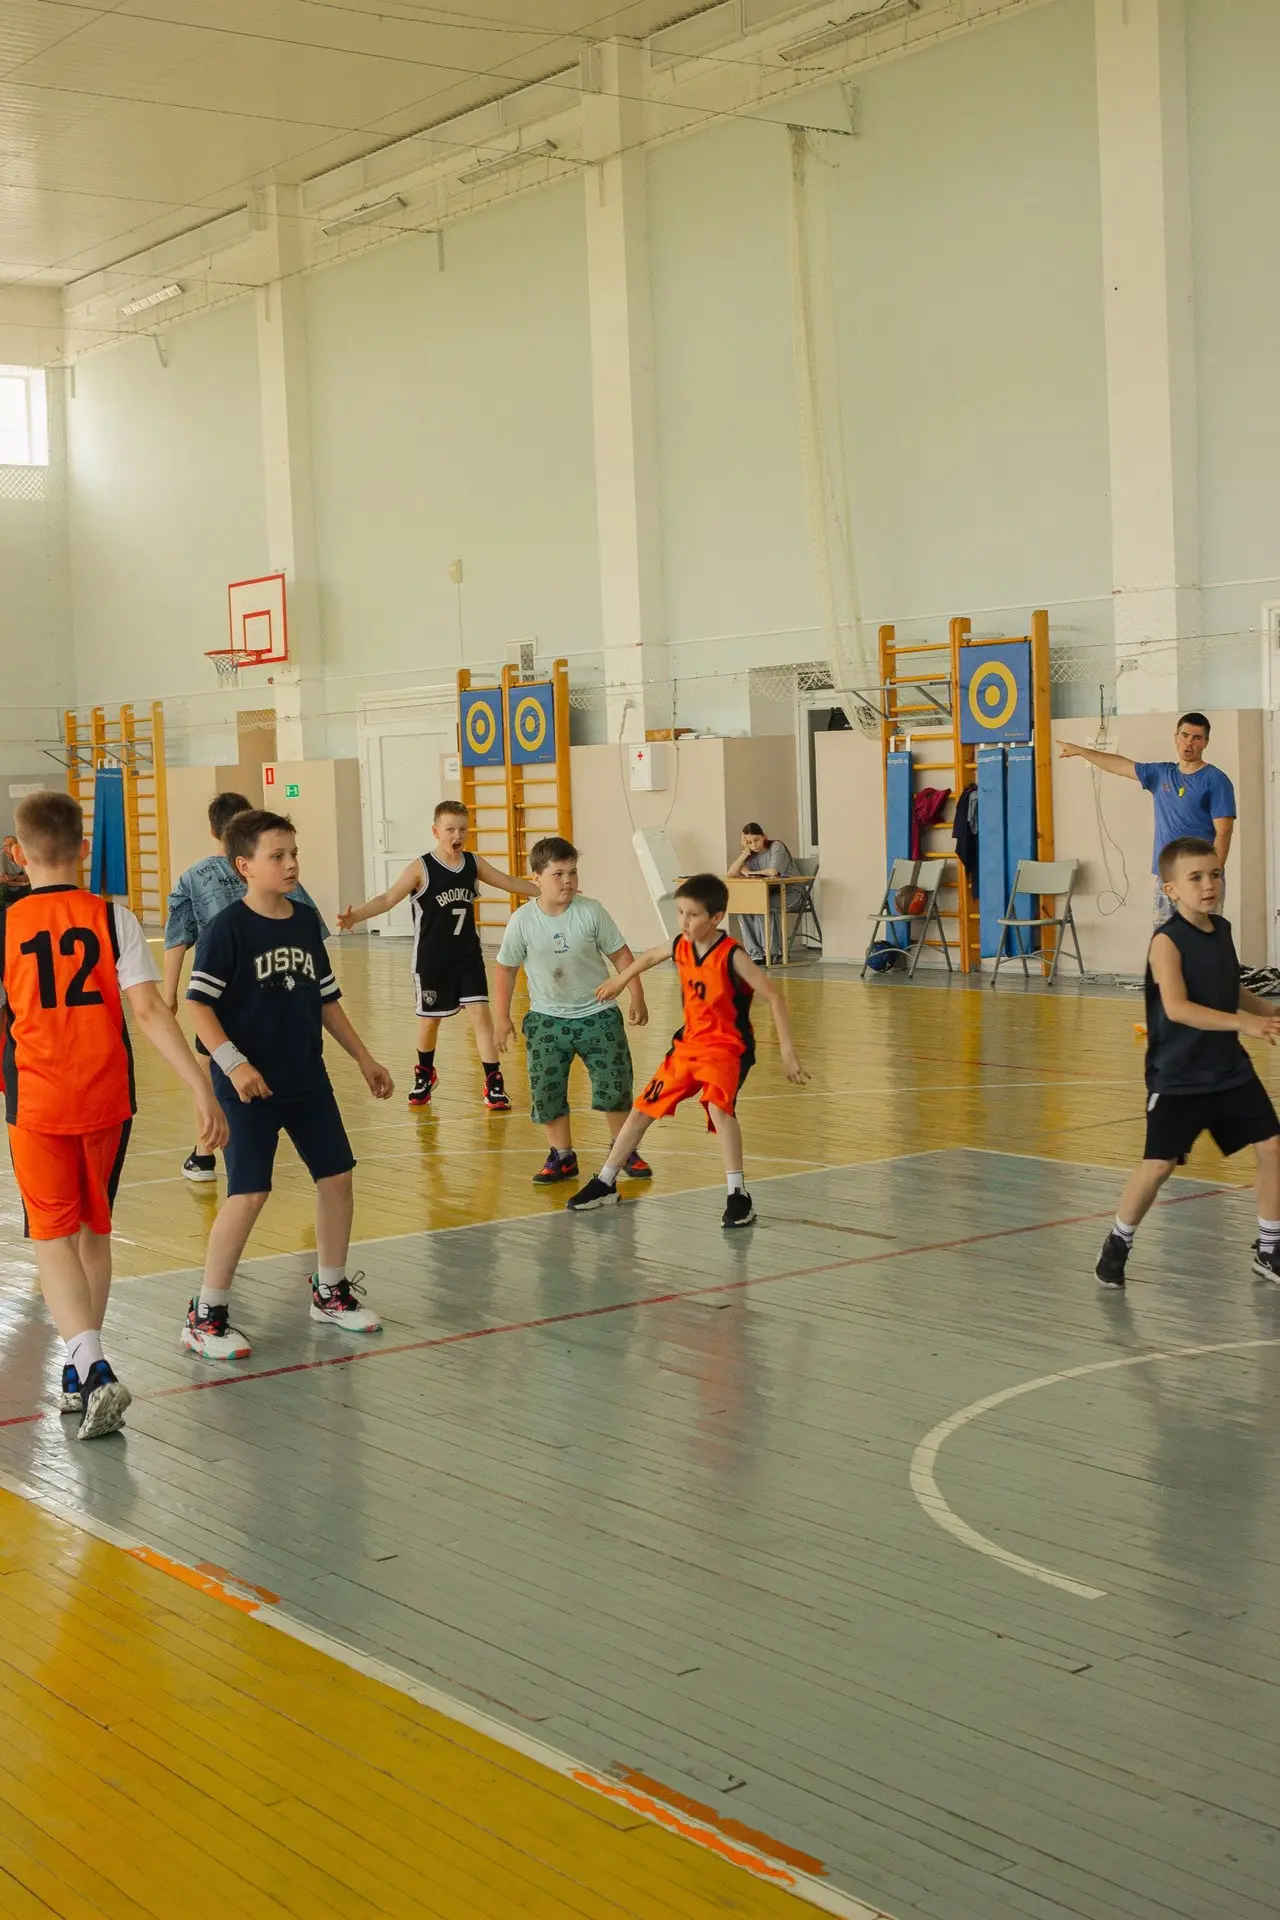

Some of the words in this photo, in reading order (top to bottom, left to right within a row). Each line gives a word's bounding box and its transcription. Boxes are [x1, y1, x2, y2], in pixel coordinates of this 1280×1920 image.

[435, 888, 474, 907] BROOKLY
[452, 908, 467, 936] 7
[20, 927, 104, 1009] 12
[254, 947, 316, 980] USPA
